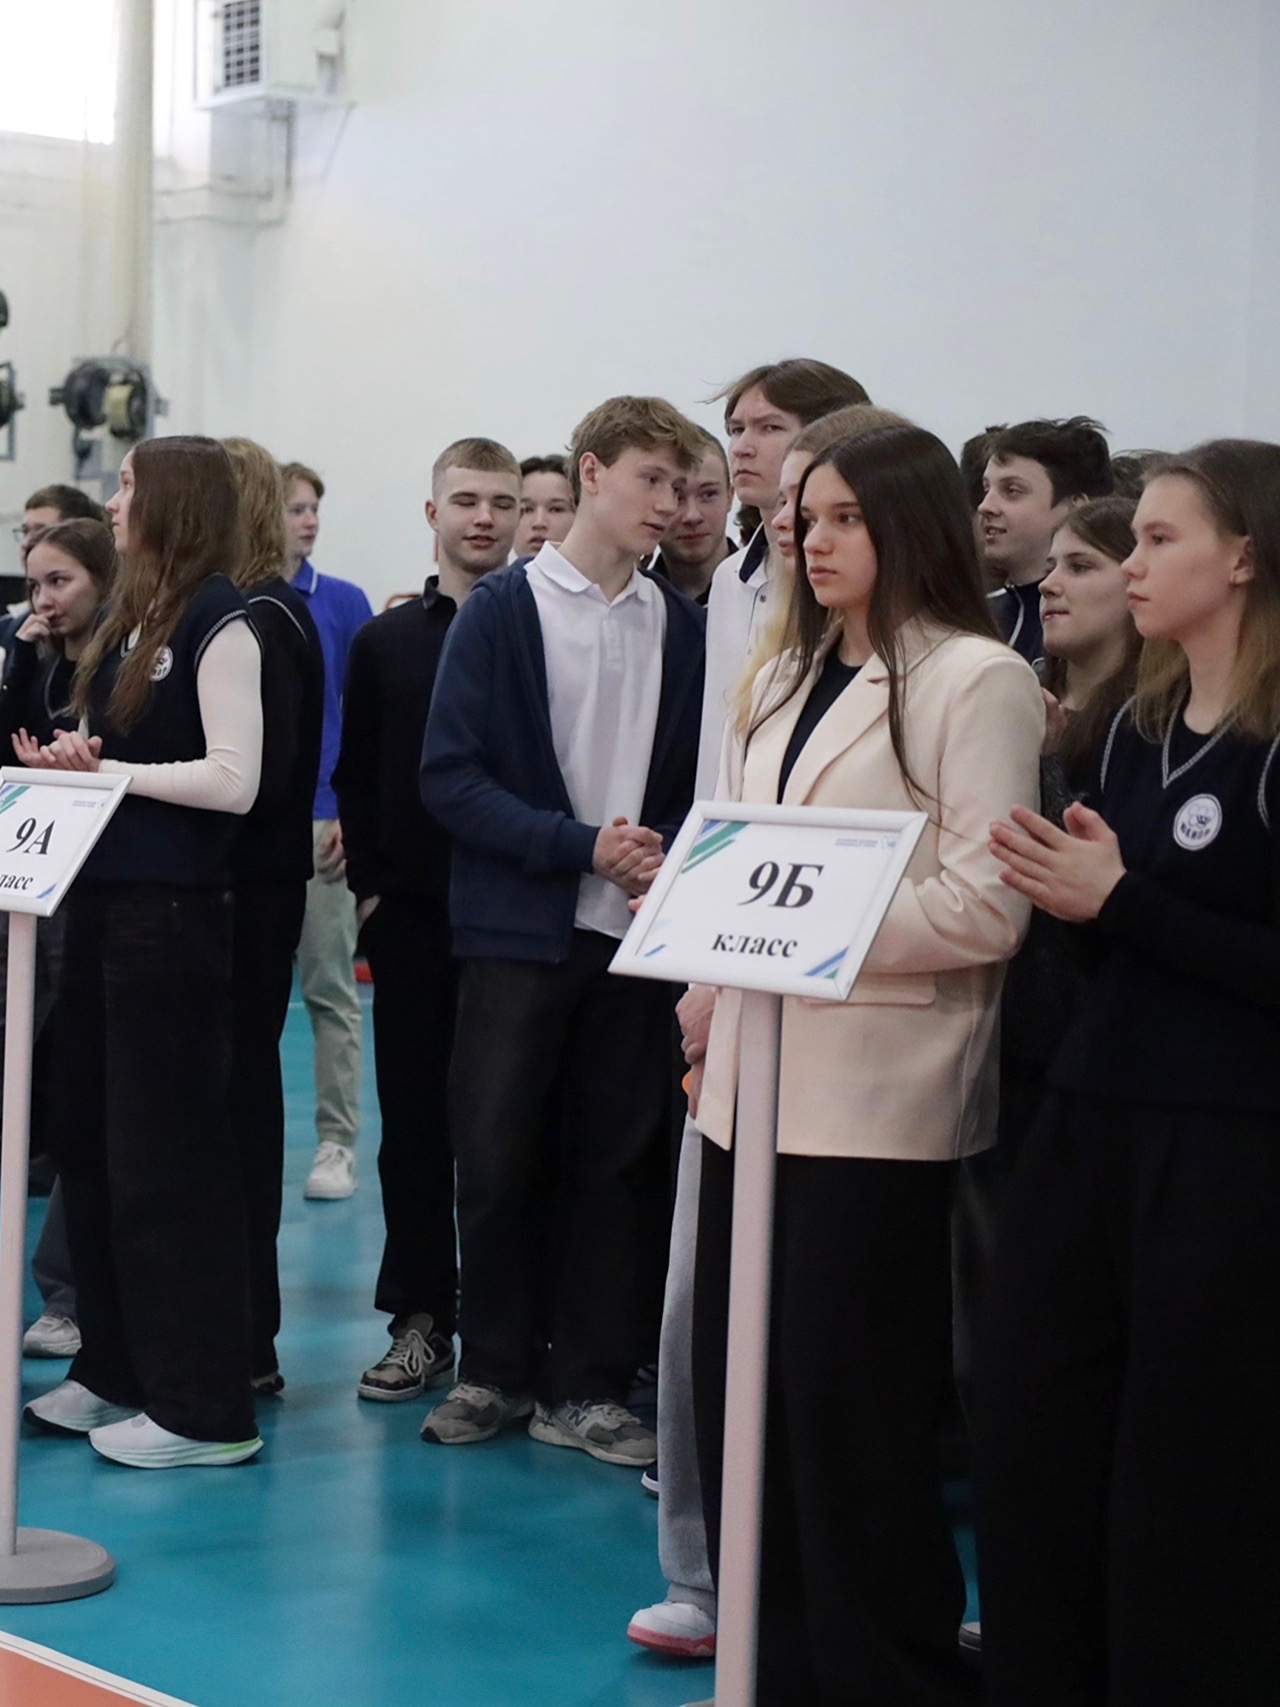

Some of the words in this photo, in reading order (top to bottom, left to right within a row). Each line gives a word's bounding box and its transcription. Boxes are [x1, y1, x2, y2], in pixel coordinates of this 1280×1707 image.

[5, 817, 55, 856] 9А
[738, 861, 825, 909] 9Б
[710, 933, 799, 959] класс
